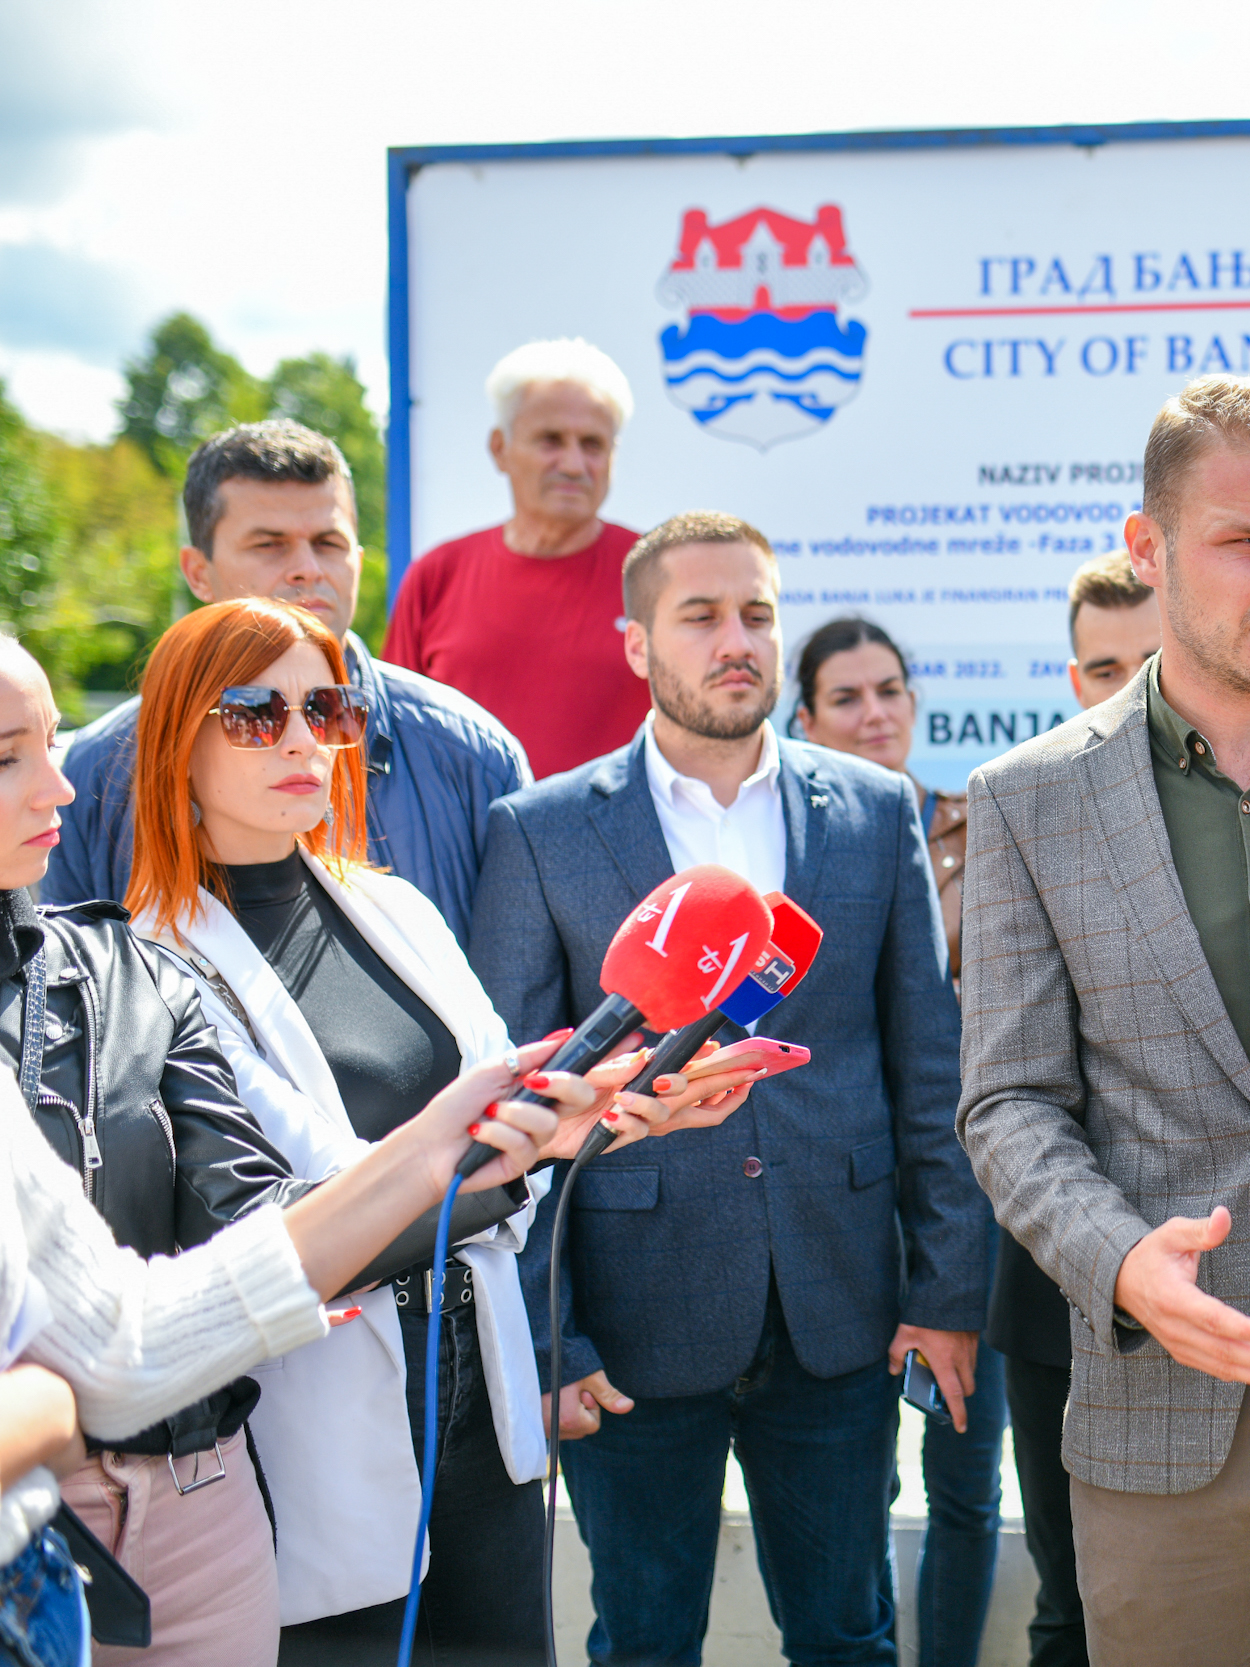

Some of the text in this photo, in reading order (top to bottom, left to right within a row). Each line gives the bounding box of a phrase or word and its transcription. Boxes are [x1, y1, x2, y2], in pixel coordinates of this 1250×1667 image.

[979, 254, 1117, 302] ГРАД
[942, 336, 1066, 380] CITY
[1080, 334, 1150, 377] OF
[978, 463, 1144, 485] NAZIV PROJ
[866, 503, 990, 527] PROJEKAT
[999, 501, 1124, 525] VODOVOD
[808, 535, 939, 557] vodovodne
[947, 532, 1020, 555] mreže
[1028, 659, 1069, 678] ZAV
